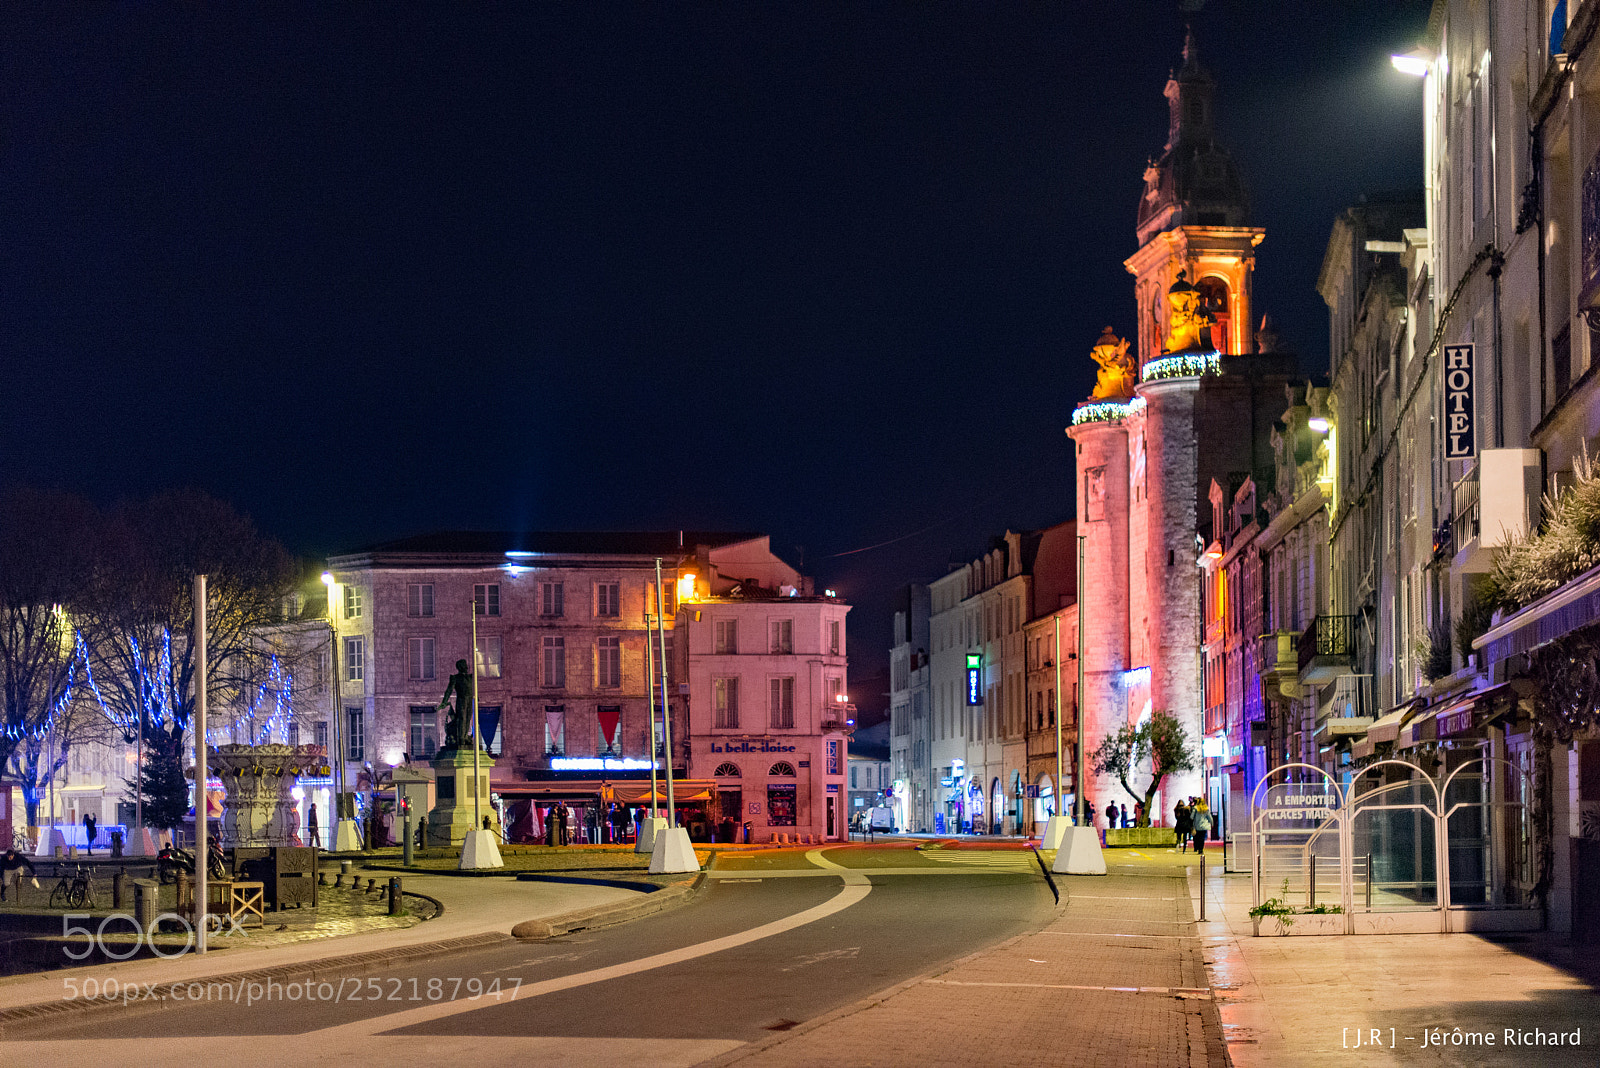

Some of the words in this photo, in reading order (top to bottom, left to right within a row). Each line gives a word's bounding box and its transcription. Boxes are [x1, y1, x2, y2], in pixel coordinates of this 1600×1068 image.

[1447, 348, 1470, 455] HOTEL
[969, 670, 977, 703] HOTEL
[711, 743, 722, 753] la
[1275, 796, 1282, 805] A
[1285, 795, 1336, 805] EMPORTER
[1268, 809, 1303, 820] GLACES
